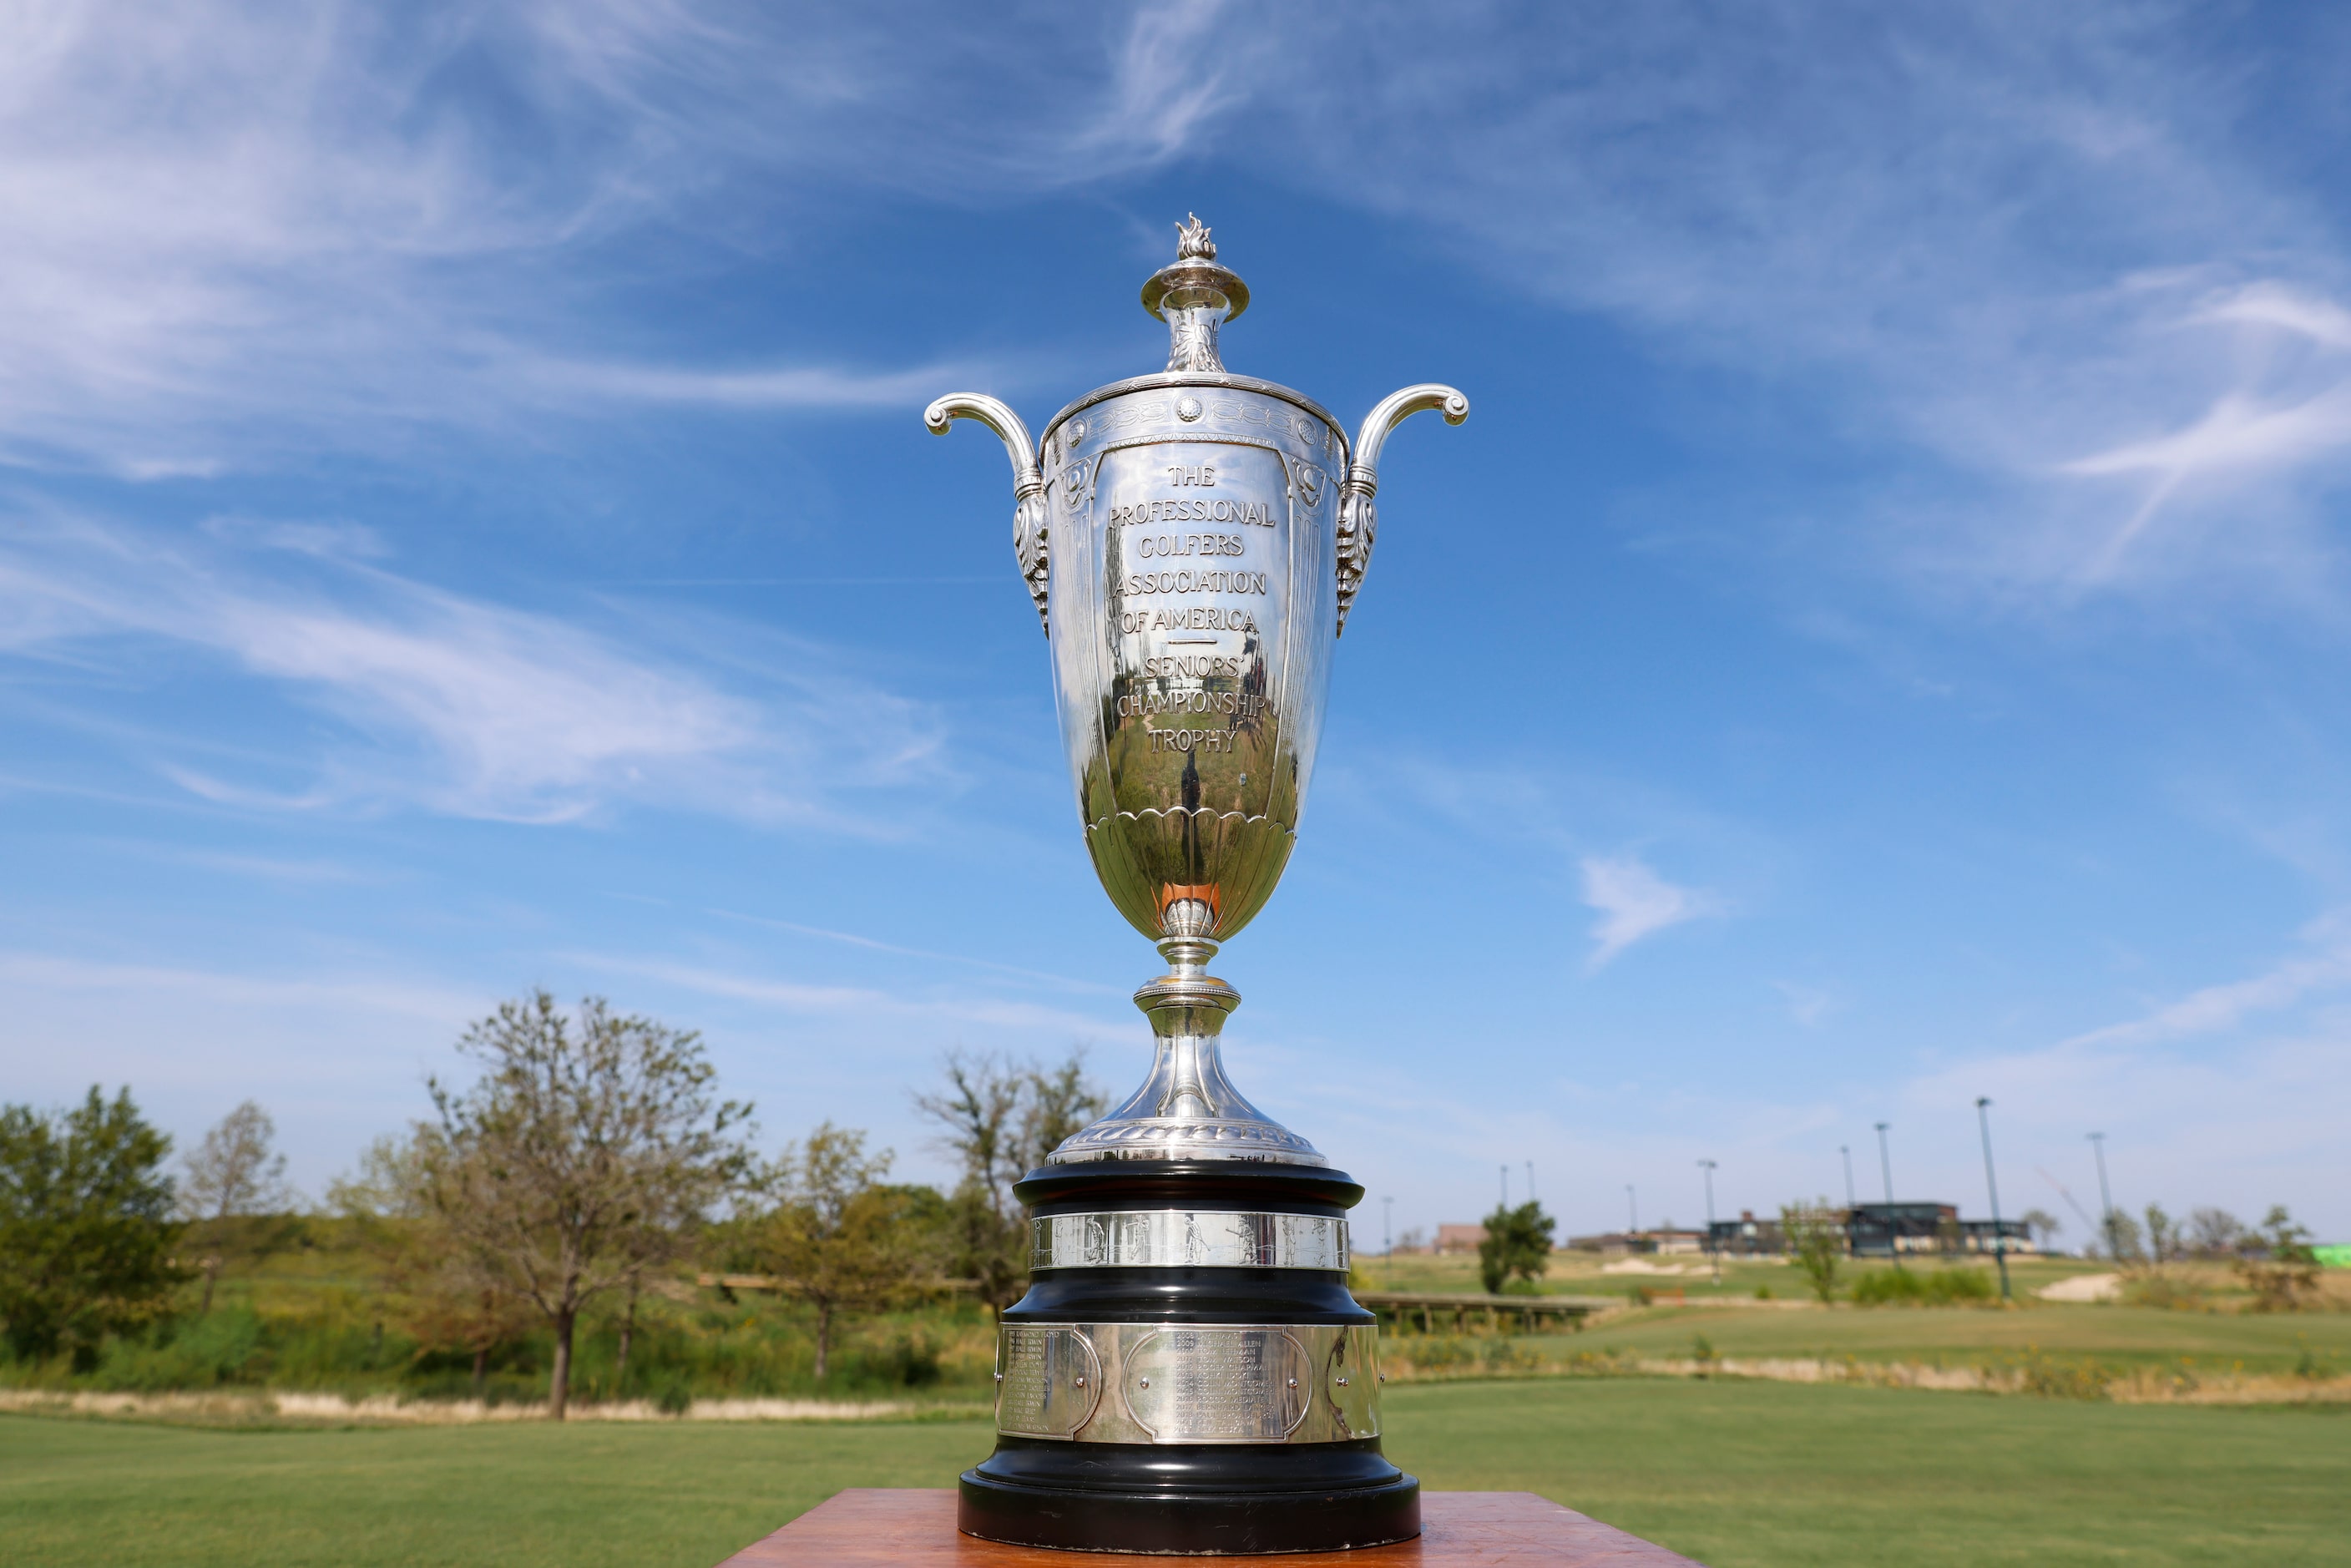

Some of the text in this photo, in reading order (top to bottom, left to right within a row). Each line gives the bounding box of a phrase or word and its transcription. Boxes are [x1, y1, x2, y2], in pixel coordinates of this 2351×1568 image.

[1168, 465, 1216, 487] THE
[1108, 499, 1276, 529] PROFESSIONAL
[1139, 534, 1244, 559] GOLFERS
[1114, 570, 1267, 596] ASSOCIATION
[1121, 607, 1257, 634] OF AMERICA
[1145, 655, 1245, 680] SENIORS'
[1116, 690, 1267, 719] CHAMPIONSHIP
[1148, 728, 1238, 755] TROPHY
[1197, 1395, 1226, 1404] ROCCO
[1231, 1395, 1265, 1404] MEDIATE
